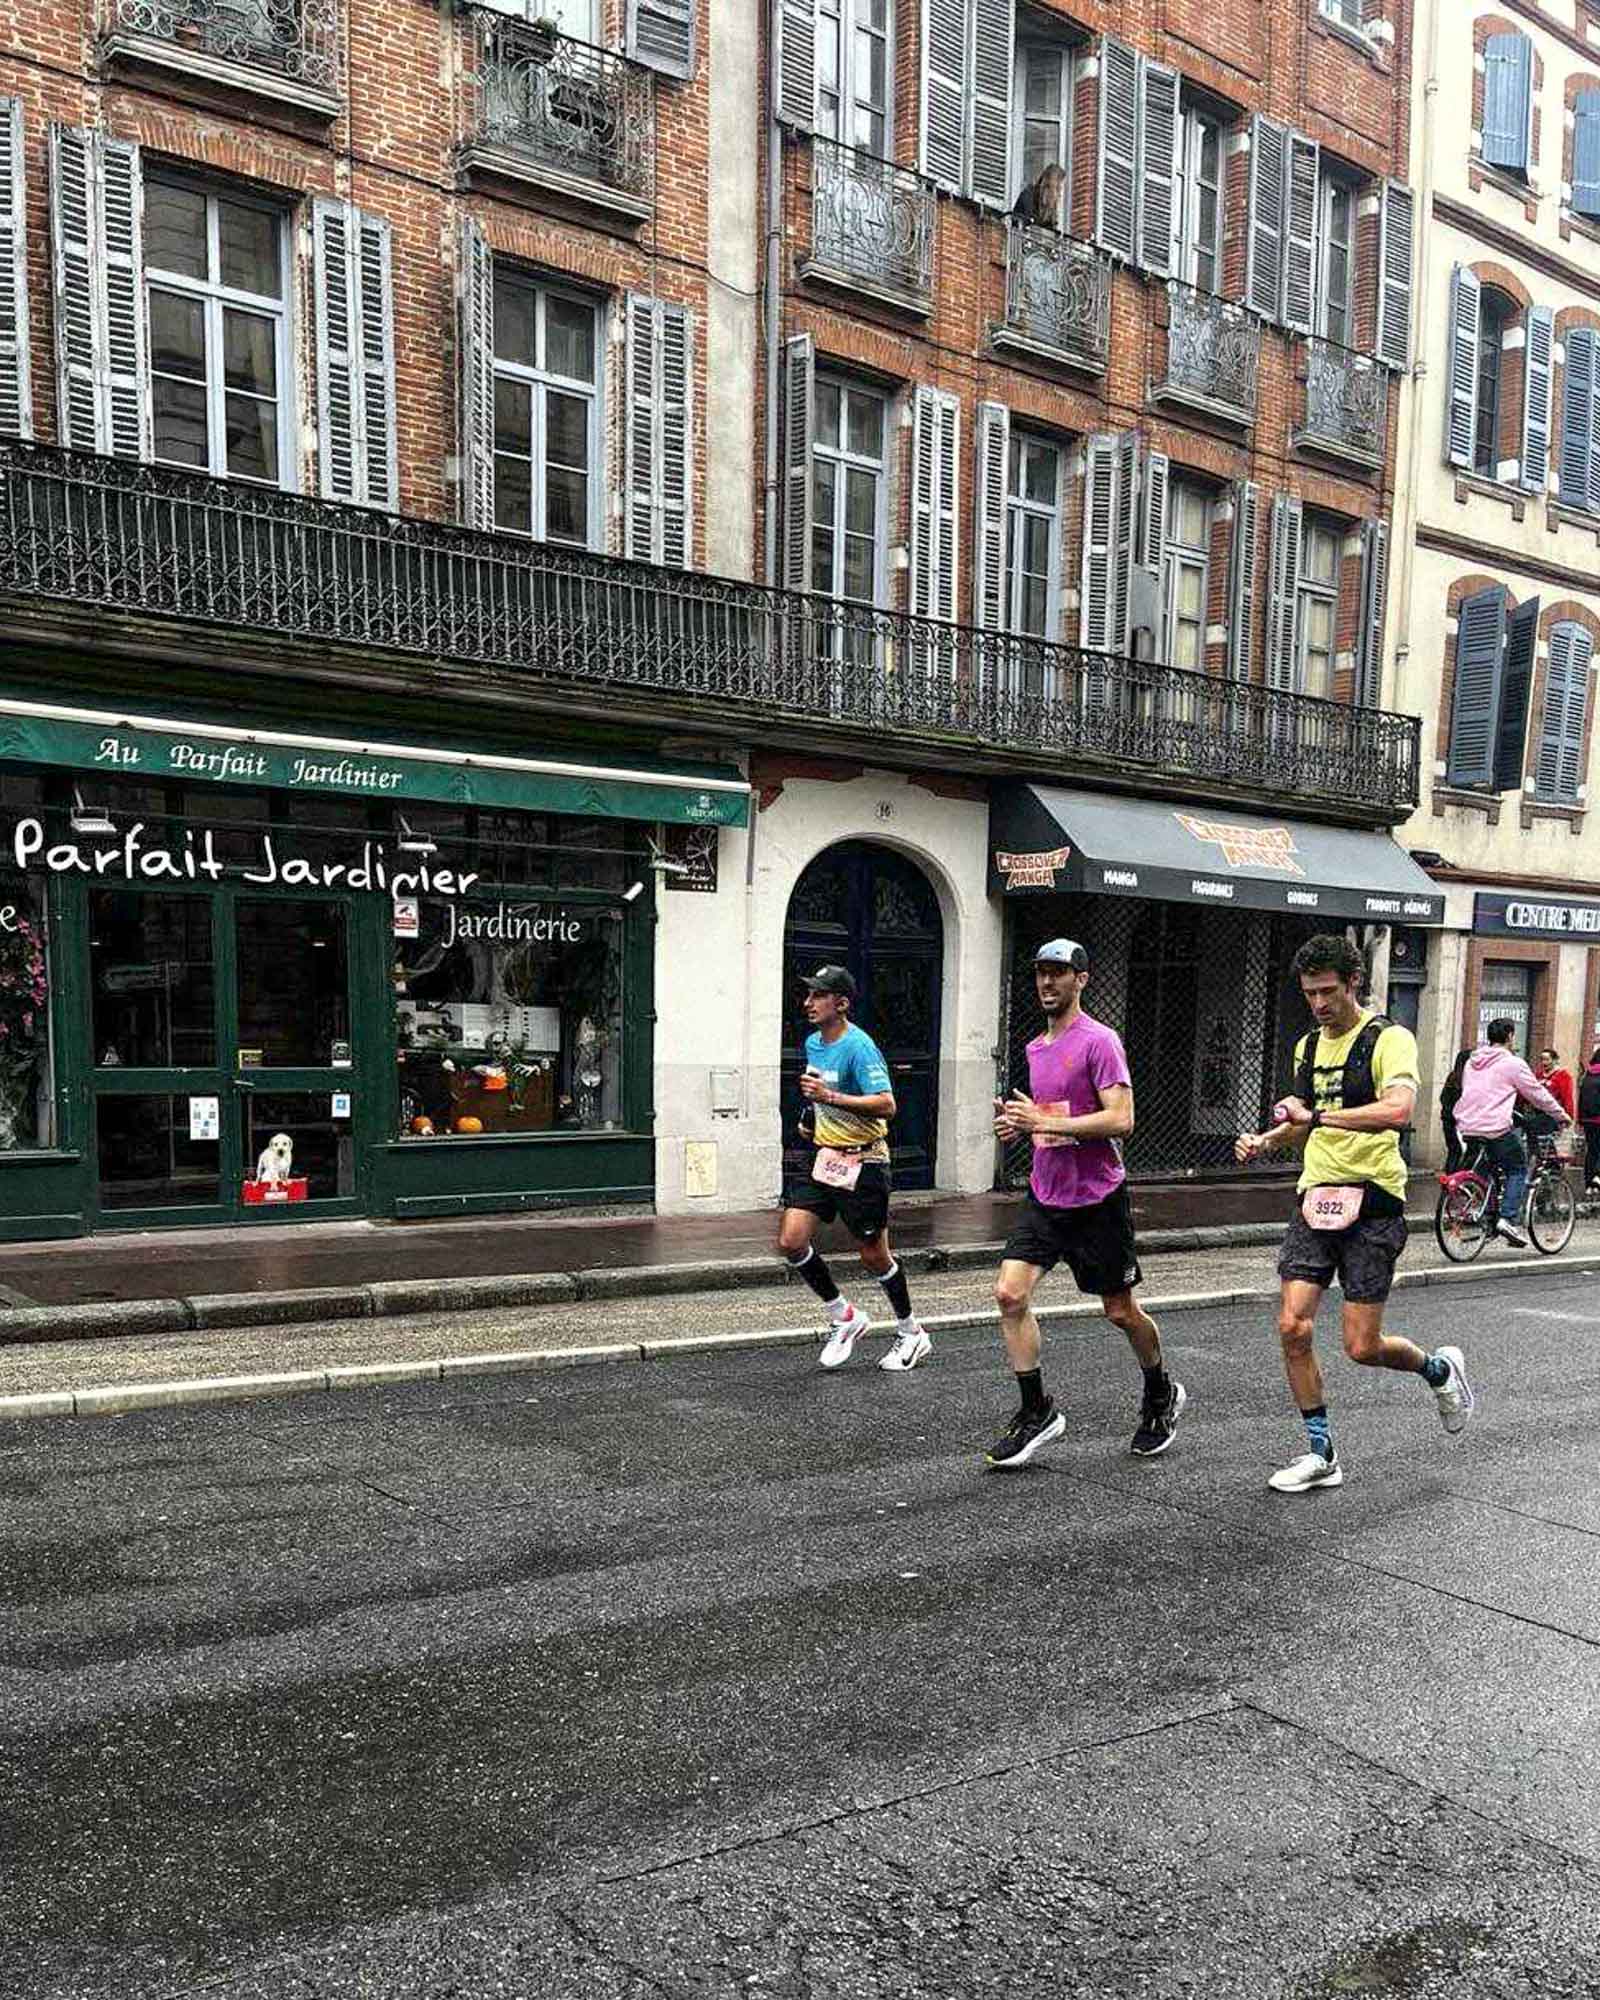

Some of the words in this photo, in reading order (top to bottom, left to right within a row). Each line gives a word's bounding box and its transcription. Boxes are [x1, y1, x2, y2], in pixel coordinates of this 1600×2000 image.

[95, 738, 141, 765] Au
[170, 744, 268, 781] Parfait
[289, 758, 403, 790] Jardinier
[13, 817, 225, 881] Parfait
[241, 834, 480, 900] Jardinier
[995, 847, 1071, 873] CROSSOVER
[1006, 868, 1056, 891] MANGA
[1103, 868, 1138, 887] MANGA
[441, 900, 582, 948] Jardinerie
[1505, 902, 1568, 929] CENTRE
[1315, 1200, 1344, 1216] 3922
